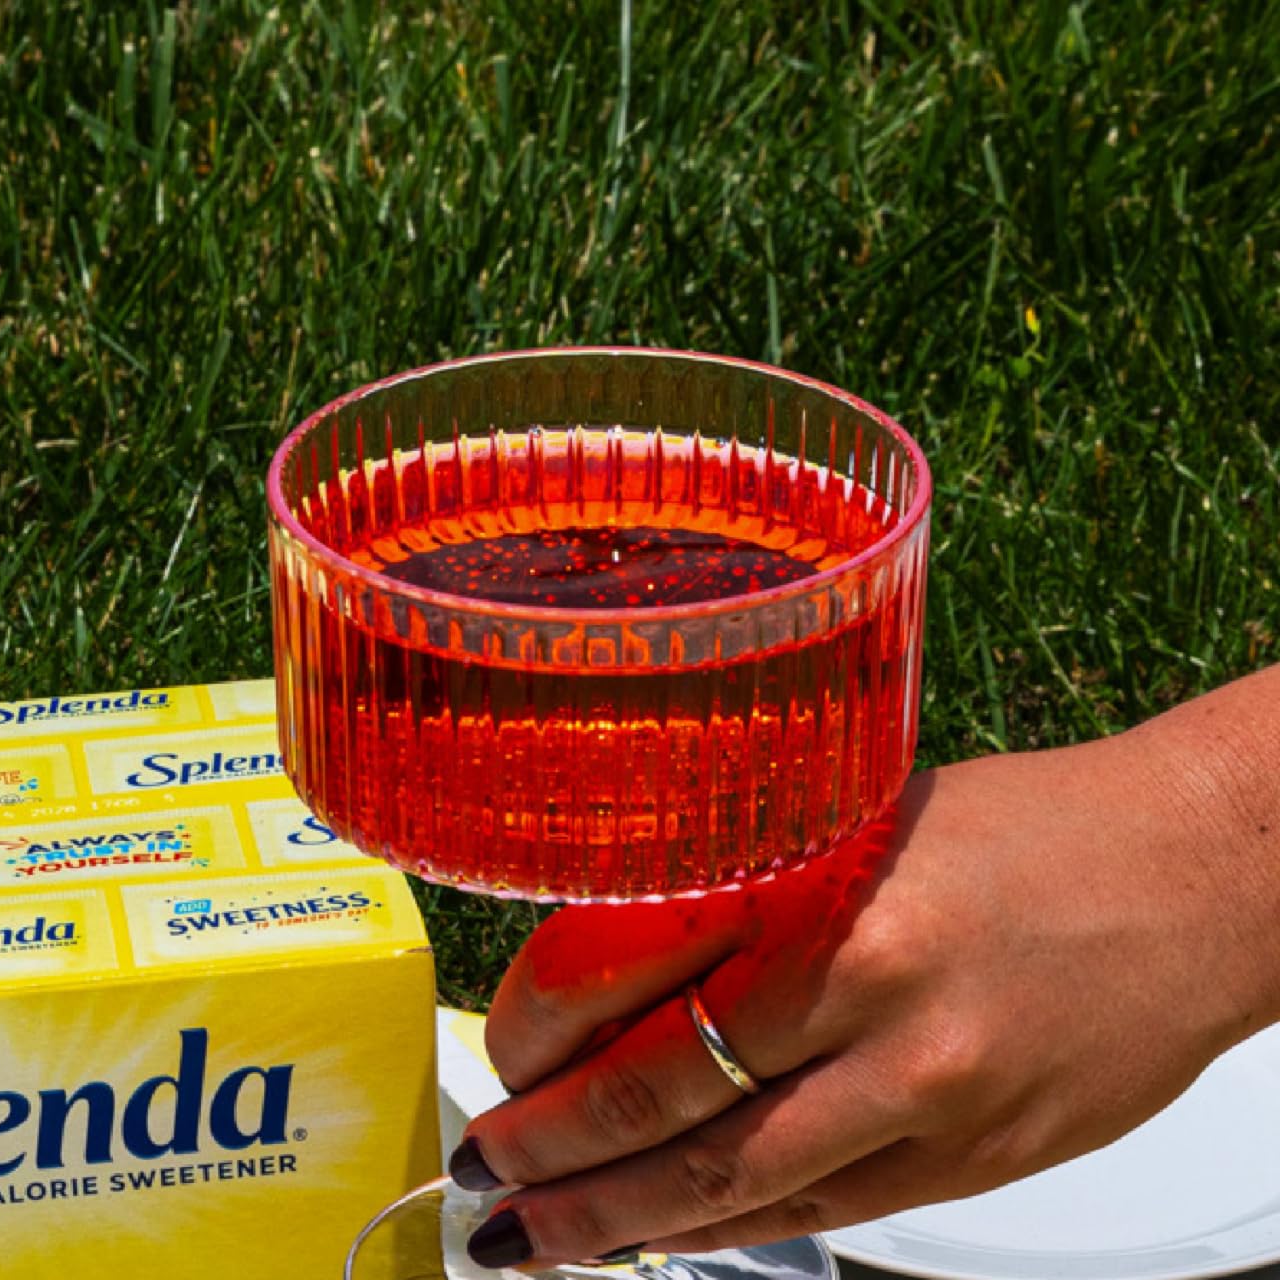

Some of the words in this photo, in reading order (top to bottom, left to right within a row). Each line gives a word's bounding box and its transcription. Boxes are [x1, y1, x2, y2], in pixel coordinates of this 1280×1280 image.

[22, 841, 136, 864] TRUST
[147, 839, 183, 853] IN
[27, 831, 175, 855] ALWAYS
[16, 851, 193, 876] YOURSELF
[166, 891, 371, 937] SWEETNESS
[110, 1153, 298, 1193] SWEETENER
